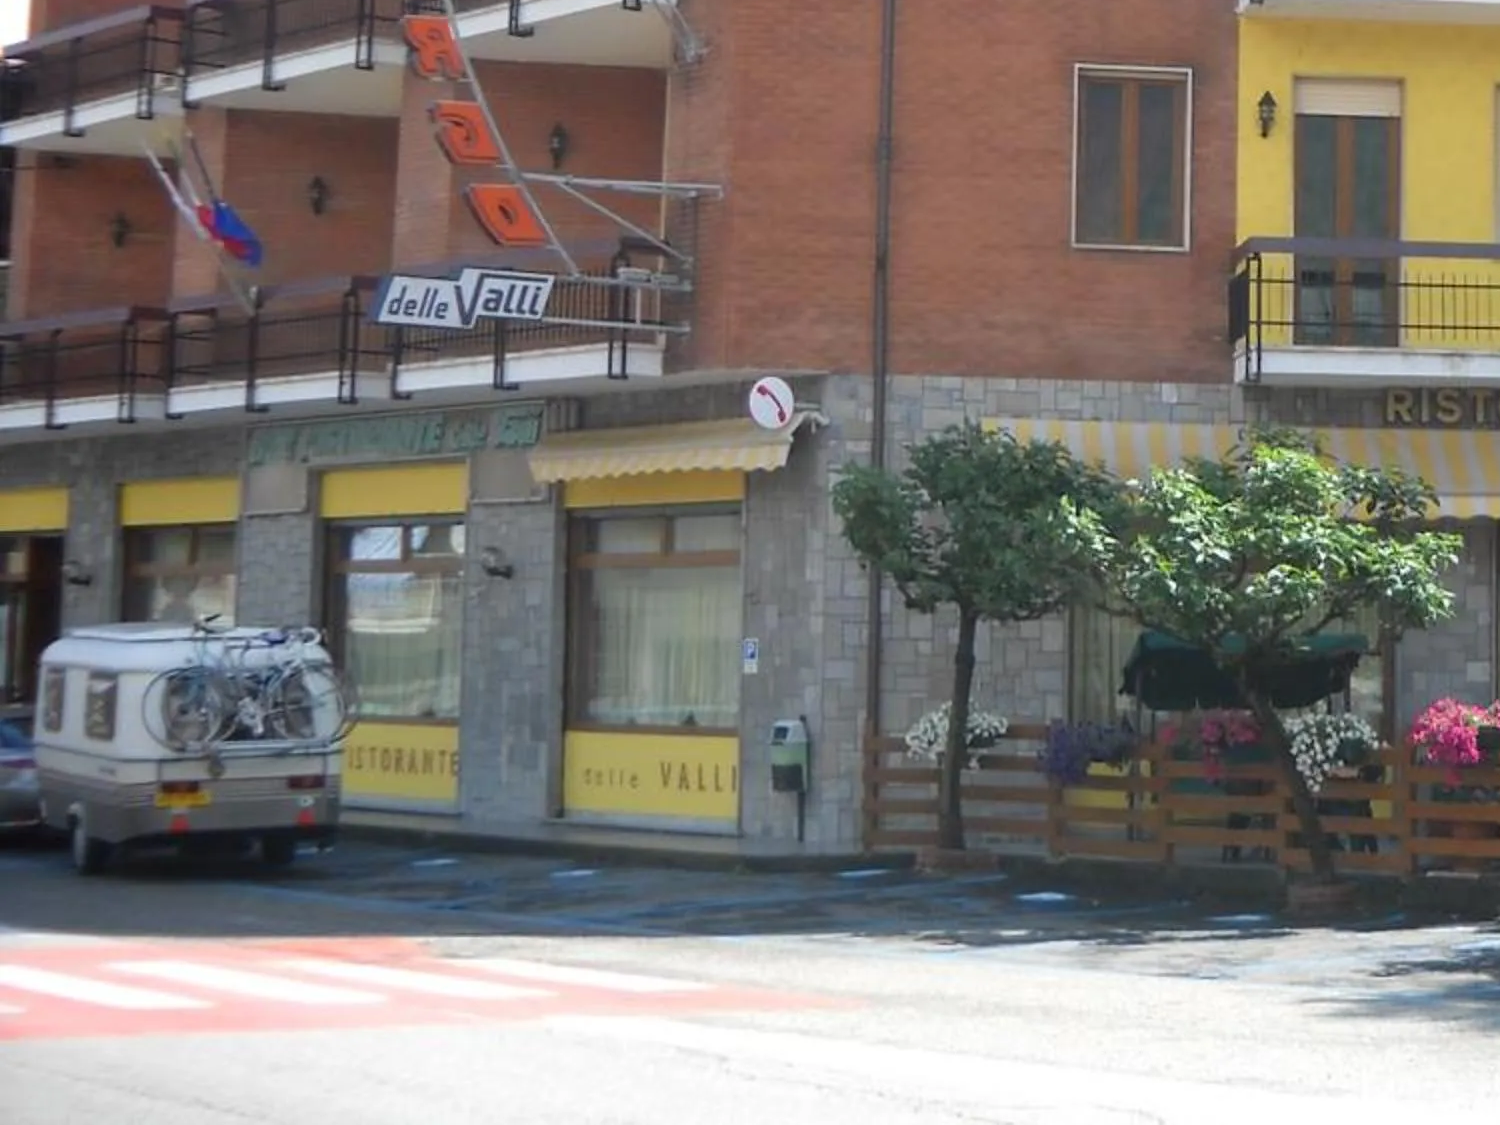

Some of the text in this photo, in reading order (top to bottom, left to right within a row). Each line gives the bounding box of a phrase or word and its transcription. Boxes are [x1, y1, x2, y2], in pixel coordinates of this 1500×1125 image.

[387, 273, 548, 326] delle Valli
[347, 743, 459, 776] ISTORANTE
[660, 761, 738, 793] VALLI
